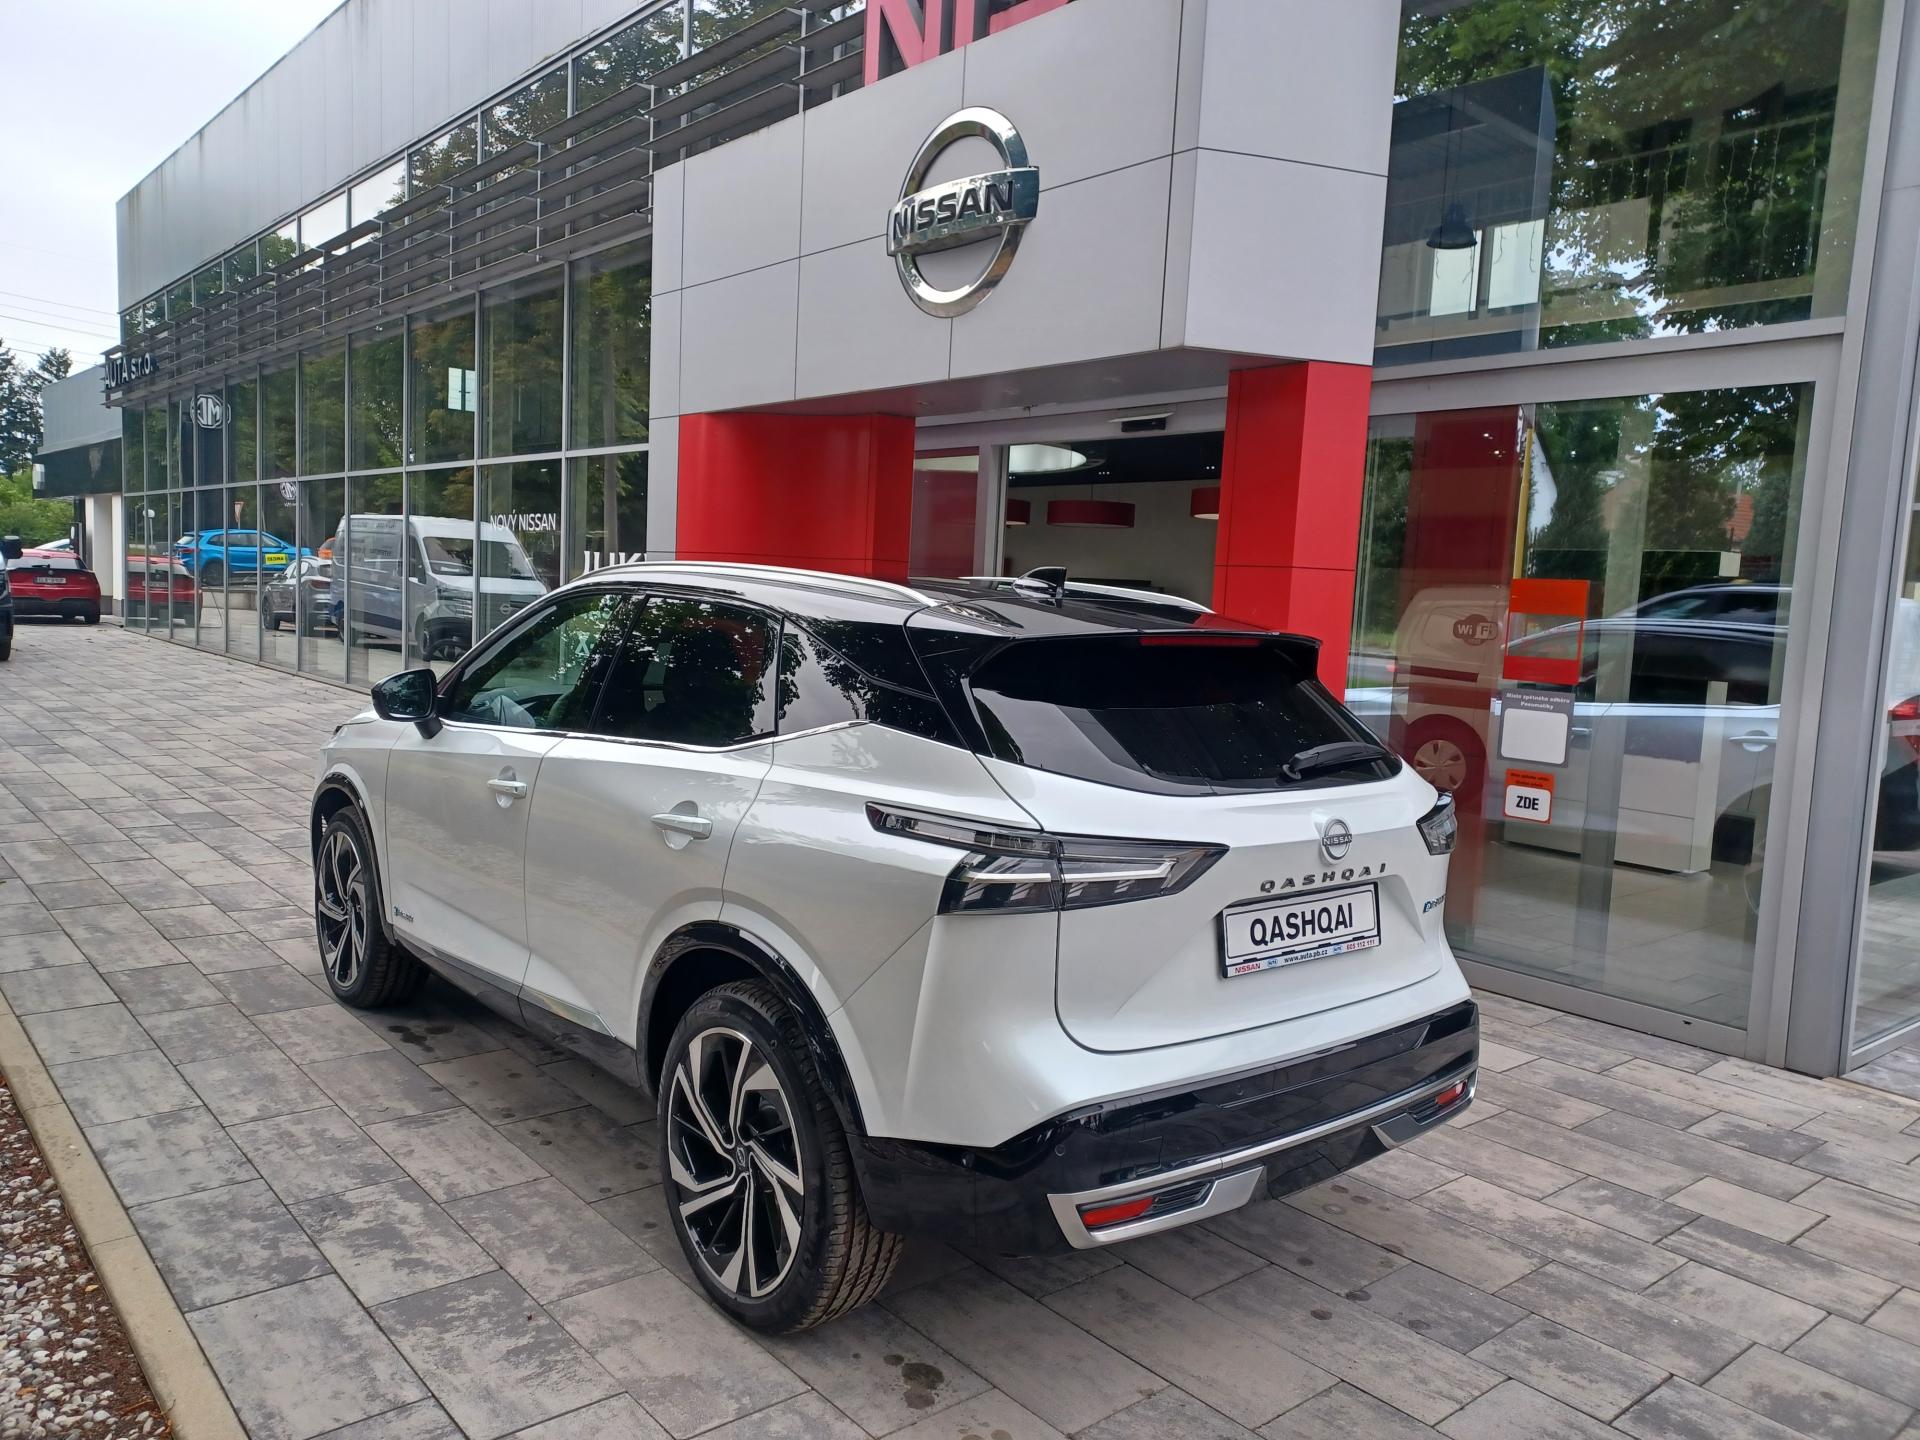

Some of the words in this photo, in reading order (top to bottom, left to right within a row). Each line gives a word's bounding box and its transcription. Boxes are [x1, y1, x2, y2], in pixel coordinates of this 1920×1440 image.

[863, 0, 1073, 87] NI
[893, 180, 1014, 241] NISSAN
[104, 356, 129, 388] AUTA
[490, 508, 518, 531] NOVÝ
[518, 512, 557, 531] NISSAN
[1516, 795, 1539, 811] ZDE
[1323, 834, 1353, 846] NISSAN
[1260, 863, 1386, 893] QASHQAI
[1250, 902, 1353, 947] QASHQAI
[1234, 962, 1261, 974] NISSAN
